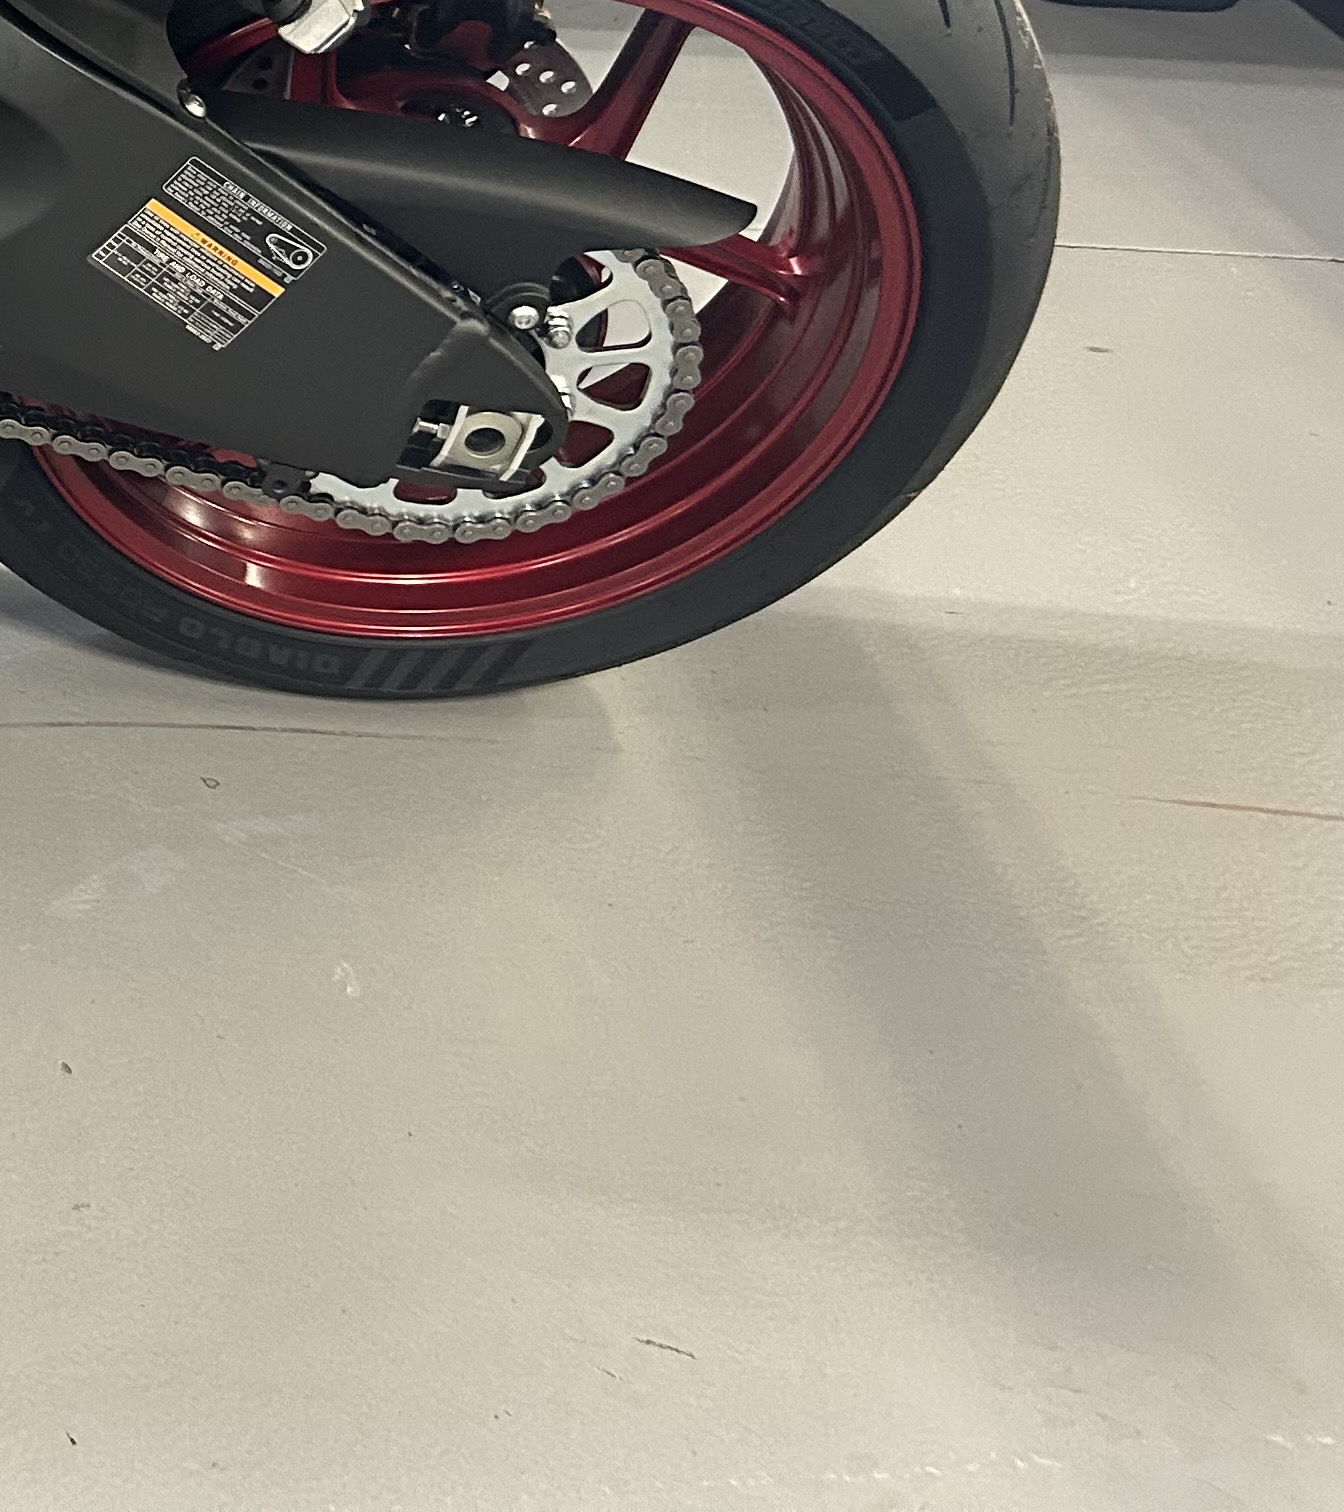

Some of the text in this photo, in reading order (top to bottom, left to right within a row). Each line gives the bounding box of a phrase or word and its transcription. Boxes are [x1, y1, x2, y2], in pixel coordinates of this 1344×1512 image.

[222, 181, 293, 231] CHAIN INFORMATION
[151, 248, 224, 300] TIRE AND LOAD DATA
[199, 237, 239, 266] WARNING
